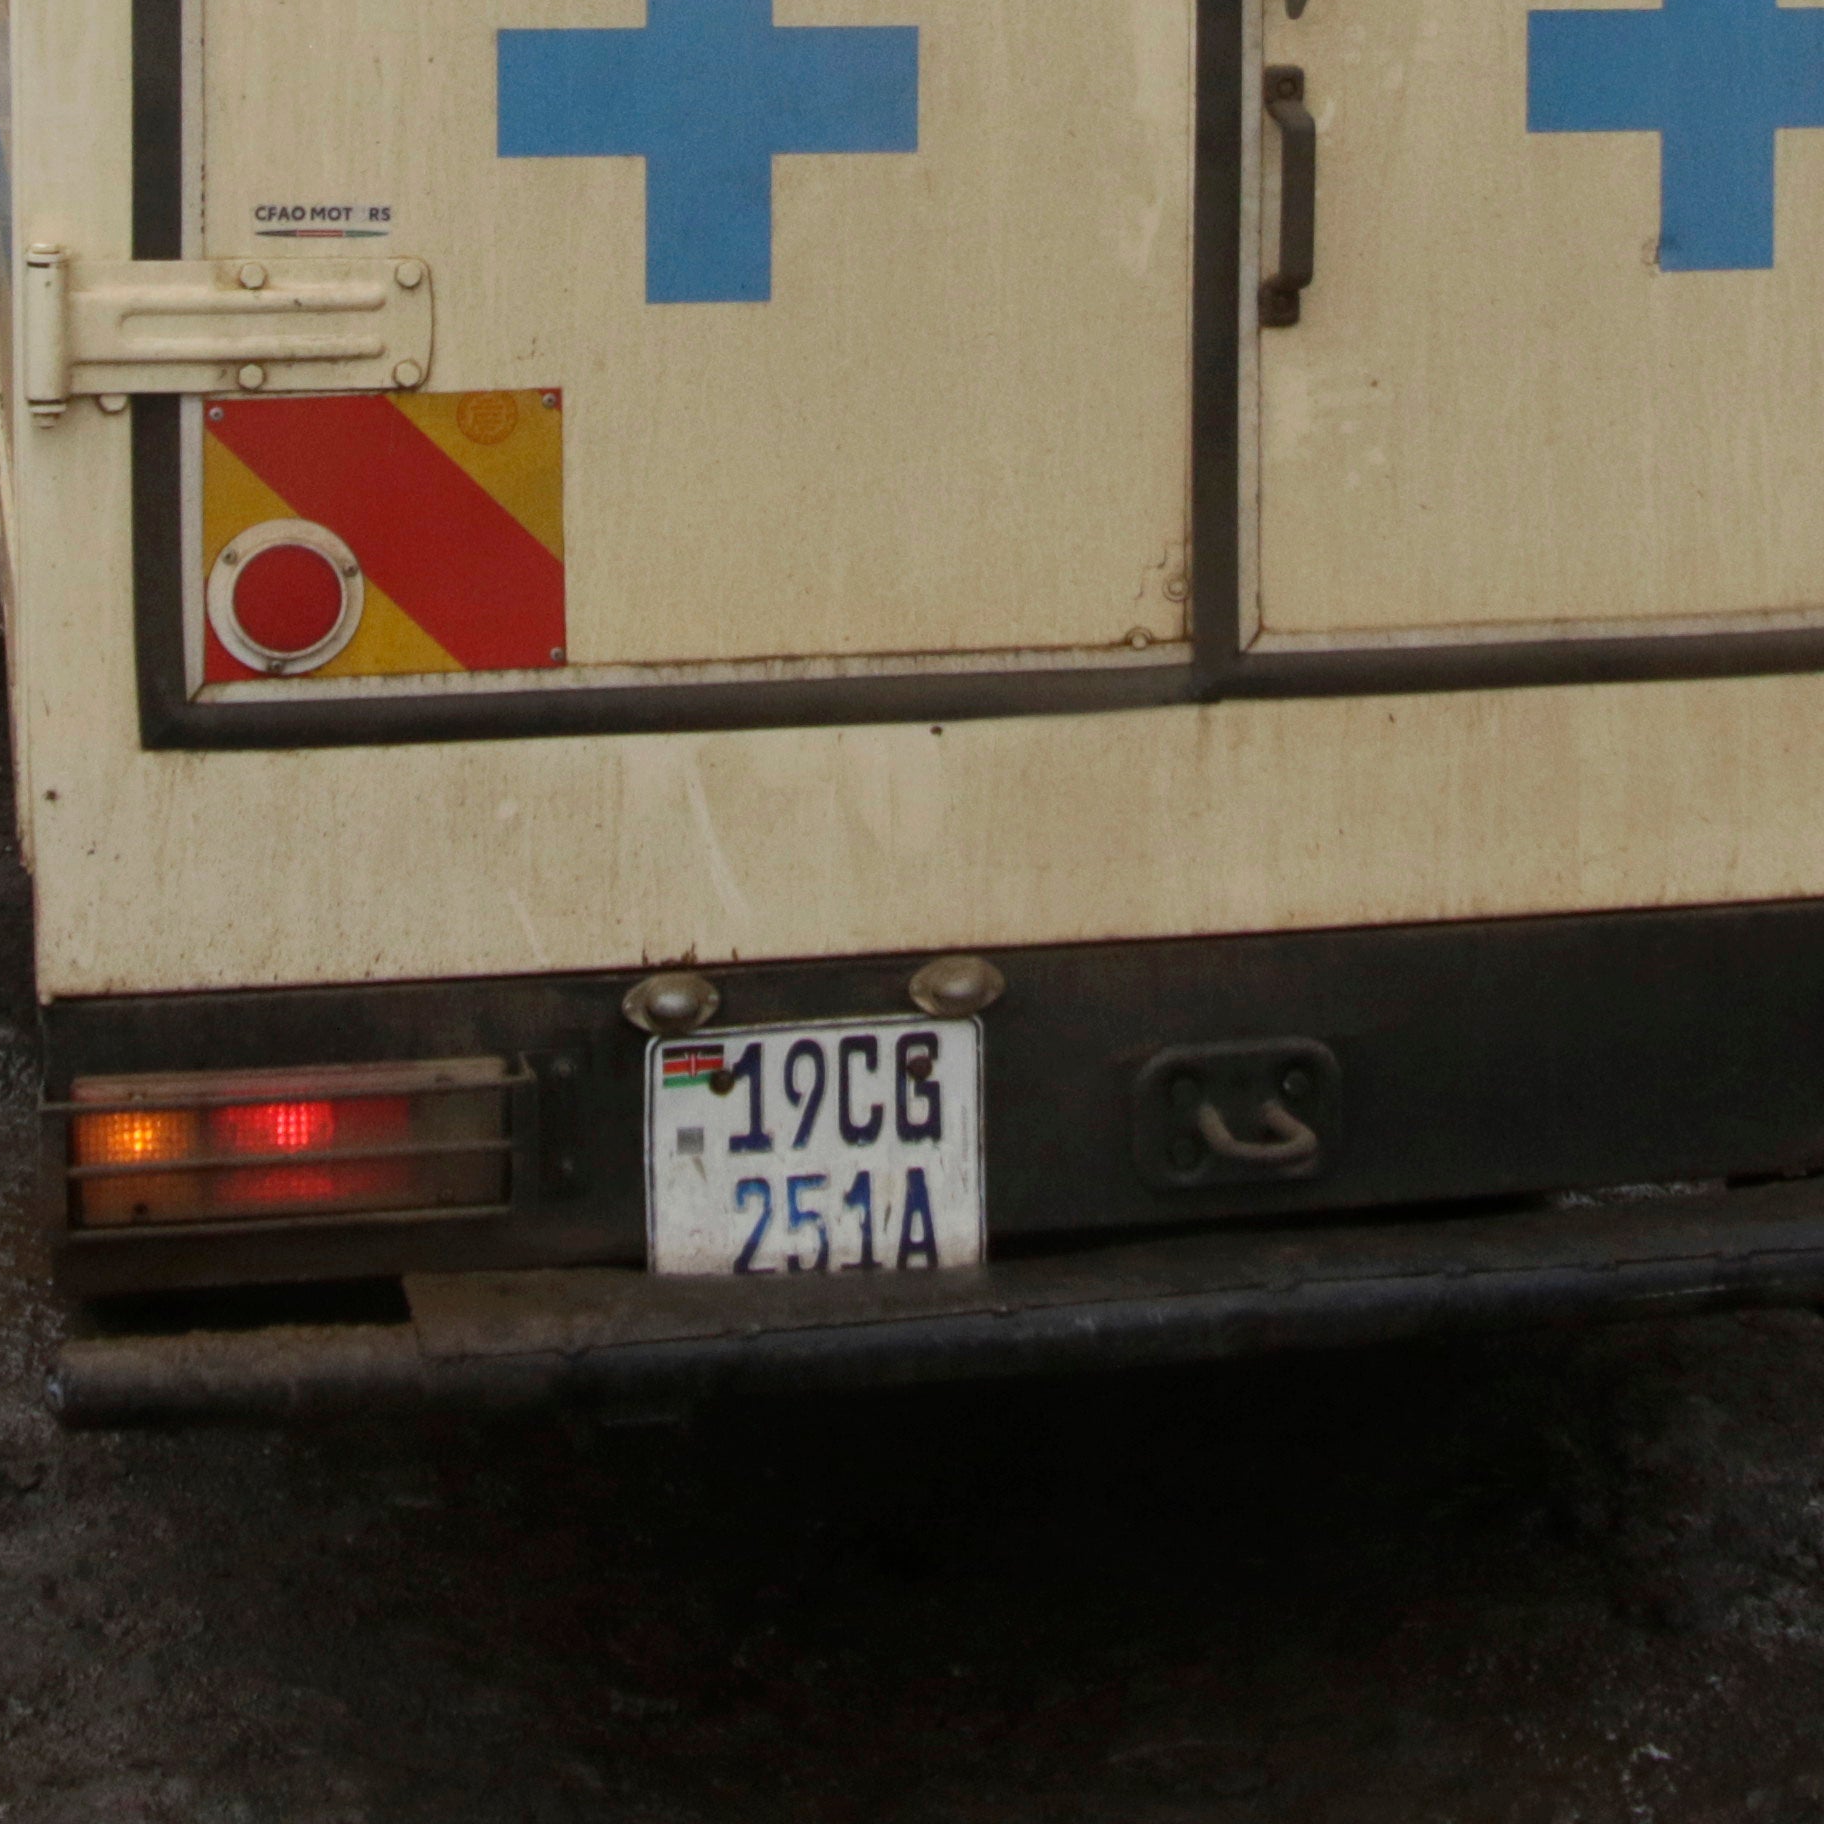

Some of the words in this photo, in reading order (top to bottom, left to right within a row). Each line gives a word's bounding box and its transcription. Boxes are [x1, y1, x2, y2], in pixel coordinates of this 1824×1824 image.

[254, 205, 306, 222] CFAO
[727, 1030, 943, 1155] 19CG
[731, 1166, 940, 1273] 251A
